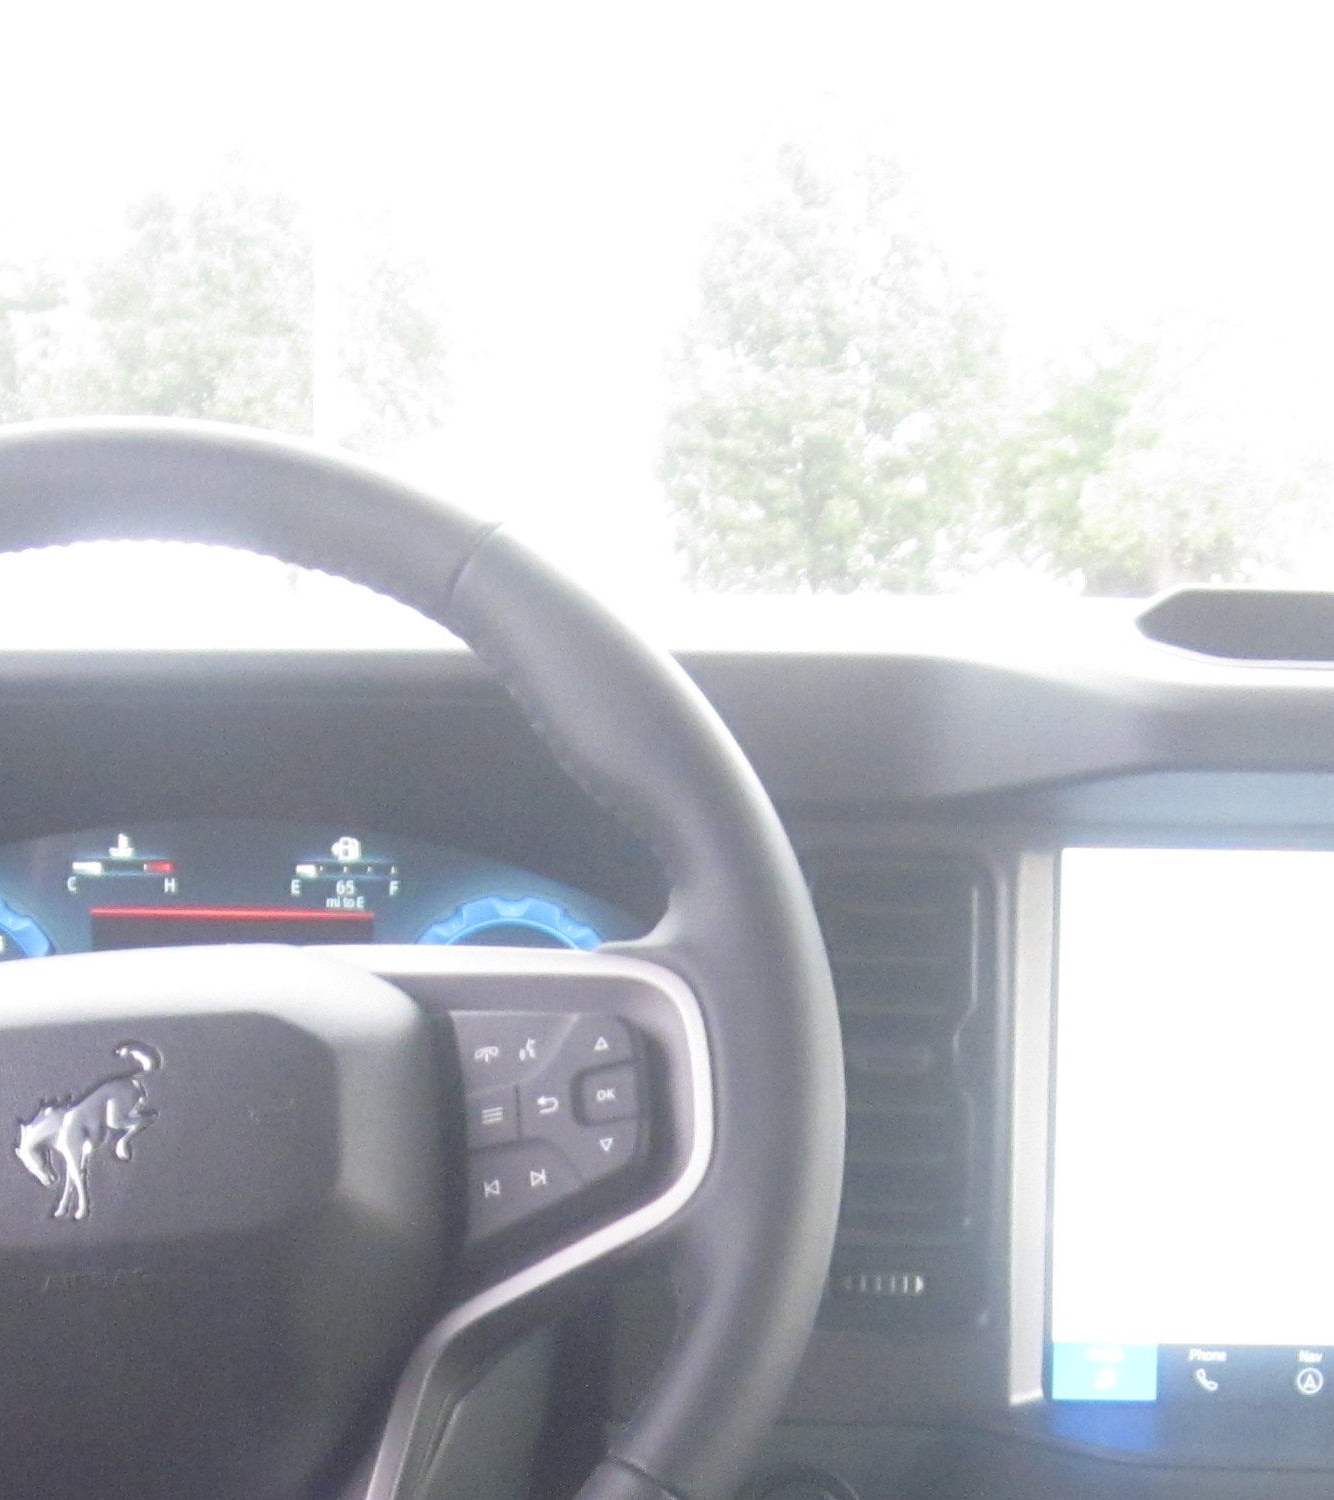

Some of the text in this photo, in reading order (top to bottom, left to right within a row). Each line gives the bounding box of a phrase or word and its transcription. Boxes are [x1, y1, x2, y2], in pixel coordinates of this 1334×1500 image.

[67, 876, 77, 893] C
[164, 877, 175, 894] H
[290, 879, 302, 896] E
[336, 879, 355, 896] 65
[389, 880, 400, 896] F
[325, 896, 365, 909] mi to E
[595, 1088, 616, 1102] OK
[1188, 1348, 1228, 1363] Phone
[1298, 1349, 1323, 1363] Nav
